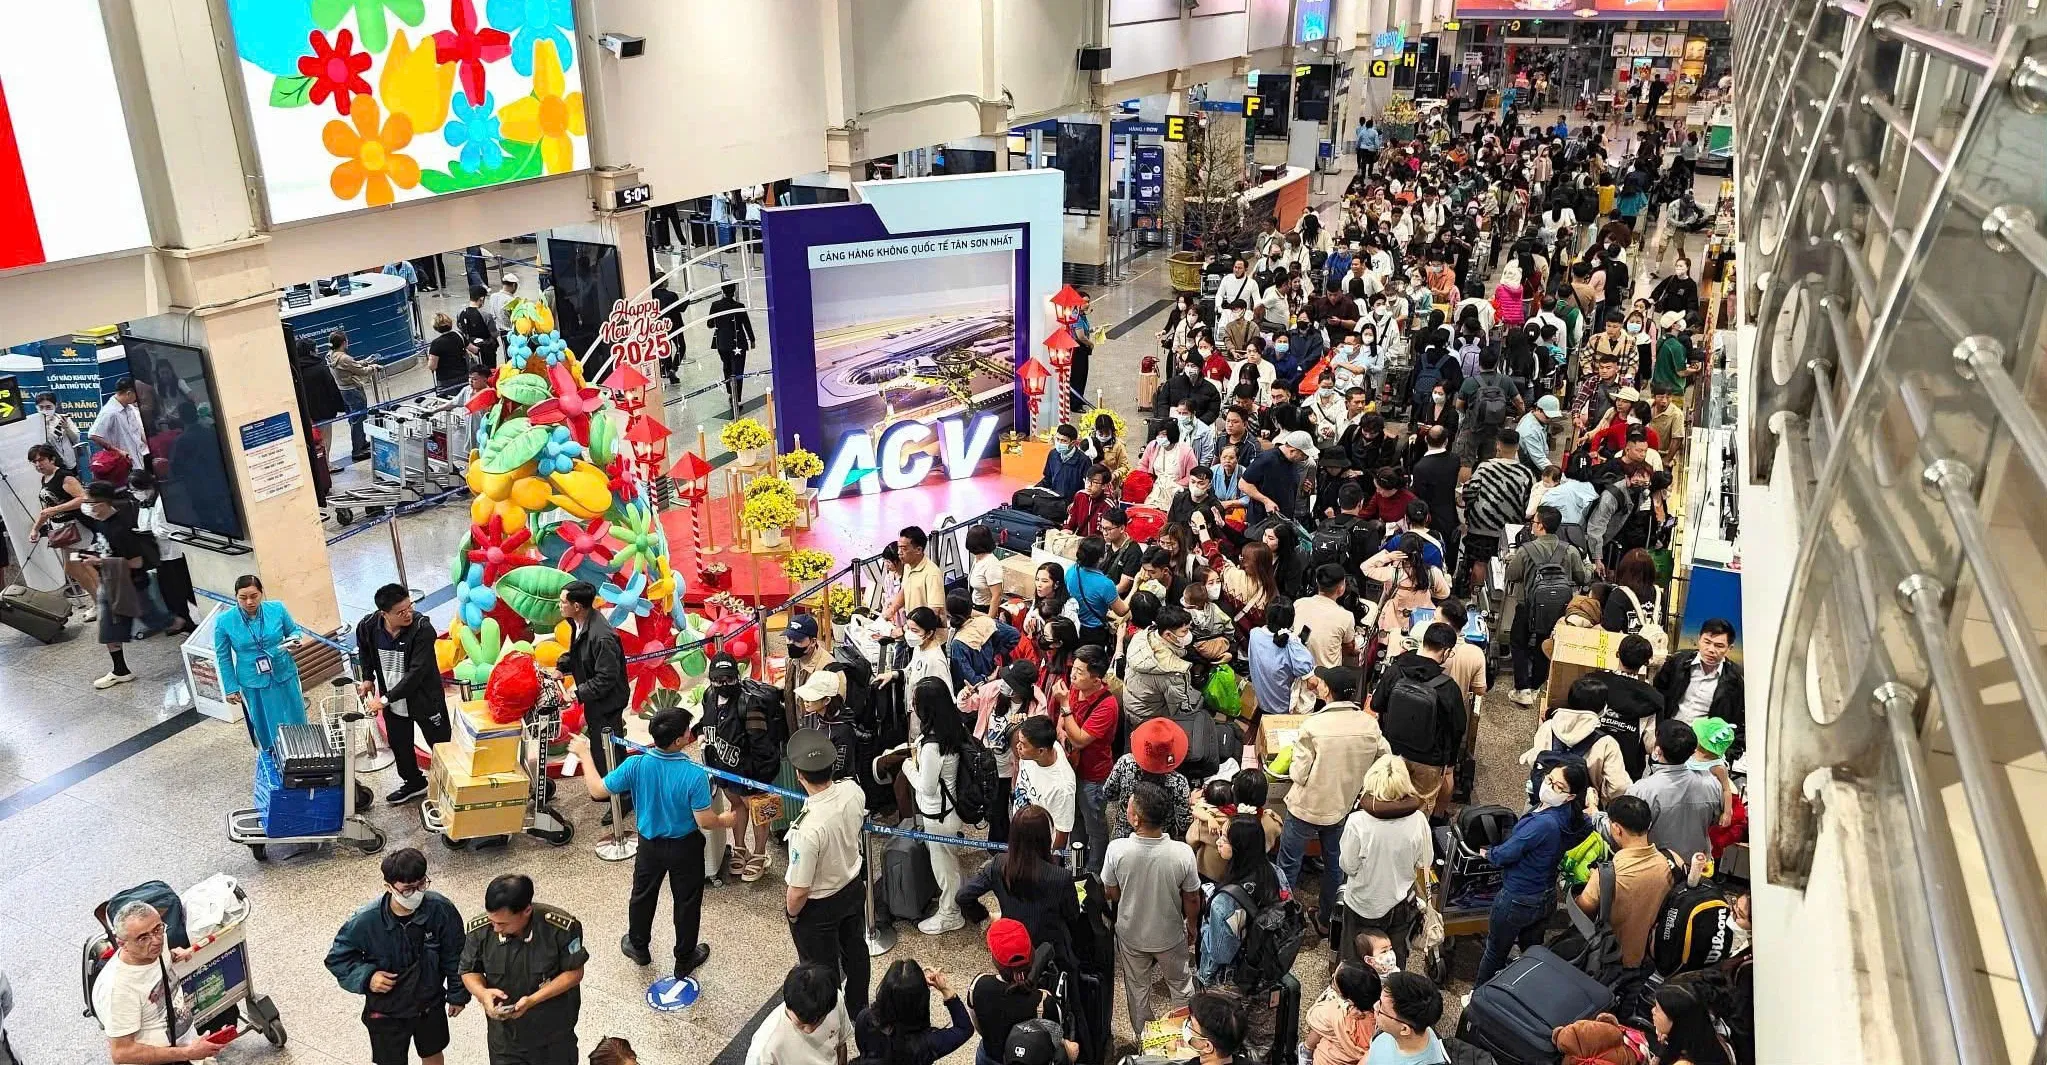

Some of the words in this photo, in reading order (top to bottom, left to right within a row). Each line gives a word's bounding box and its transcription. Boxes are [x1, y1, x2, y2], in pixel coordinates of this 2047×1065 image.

[1373, 60, 1385, 76] G
[1404, 53, 1415, 67] H
[1247, 97, 1261, 116] F
[1169, 118, 1184, 139] E
[624, 187, 648, 203] 5:04
[819, 246, 846, 262] CẢNG
[849, 247, 874, 260] HÀNG
[877, 245, 909, 257] KHÔNG
[911, 240, 936, 255] QUỐC
[938, 239, 949, 251] TẾ
[951, 240, 968, 250] TÂN
[970, 238, 988, 249] SƠN
[990, 234, 1014, 246] NHẤT
[610, 299, 661, 321] Happy
[601, 320, 632, 342] New
[634, 317, 672, 343] Year
[612, 333, 670, 369] 2025
[818, 410, 999, 501] ACV
[873, 825, 892, 834] TIA
[1704, 907, 1728, 964] Wilson
